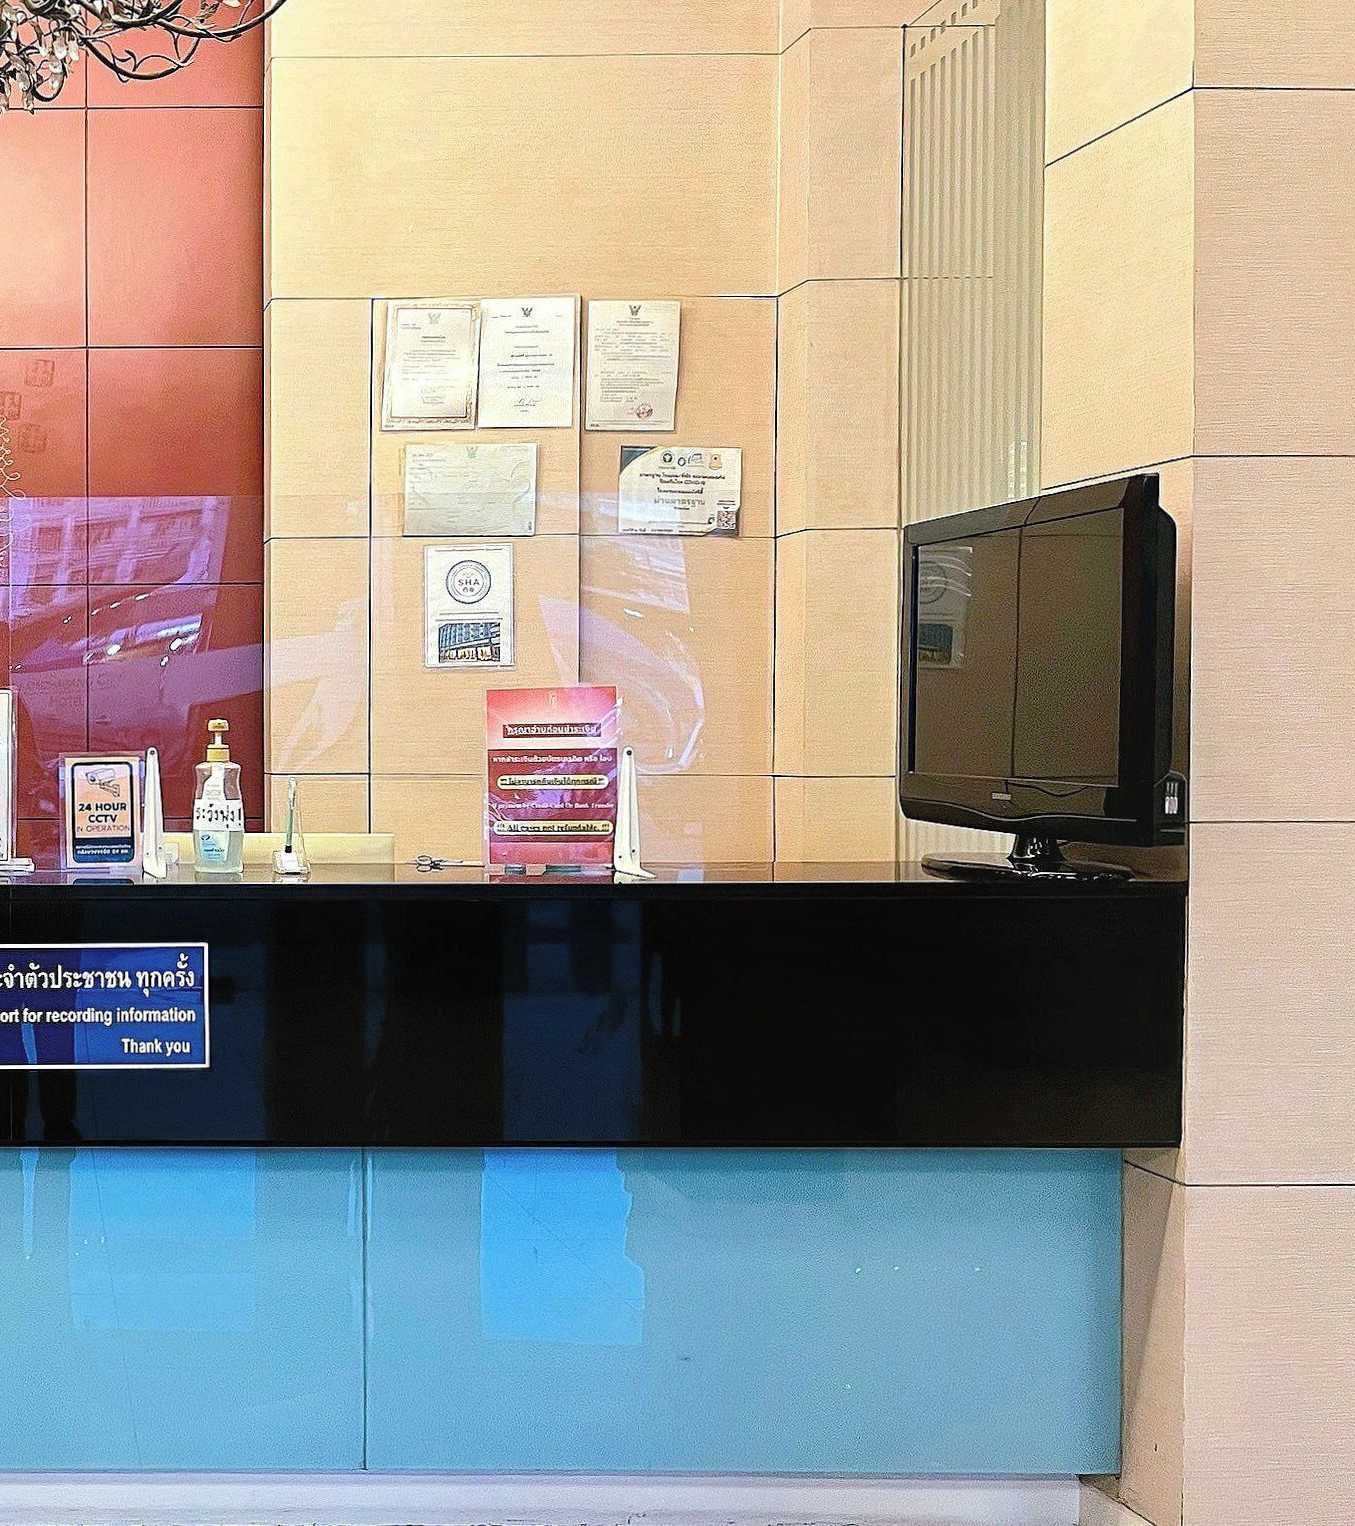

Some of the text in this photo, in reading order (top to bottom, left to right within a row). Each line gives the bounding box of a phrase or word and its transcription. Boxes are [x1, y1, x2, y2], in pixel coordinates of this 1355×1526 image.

[458, 578, 480, 587] SHA
[78, 802, 127, 812] 24 HOUR
[88, 814, 118, 824] CCTV
[85, 825, 131, 833] OPERATION
[508, 824, 519, 833] All
[543, 824, 556, 833] not
[135, 952, 195, 998] ทุกครั้ง
[22, 1007, 44, 1023] for
[45, 1007, 113, 1027] recording
[116, 1006, 196, 1023] information
[121, 1037, 191, 1057] Thank you
